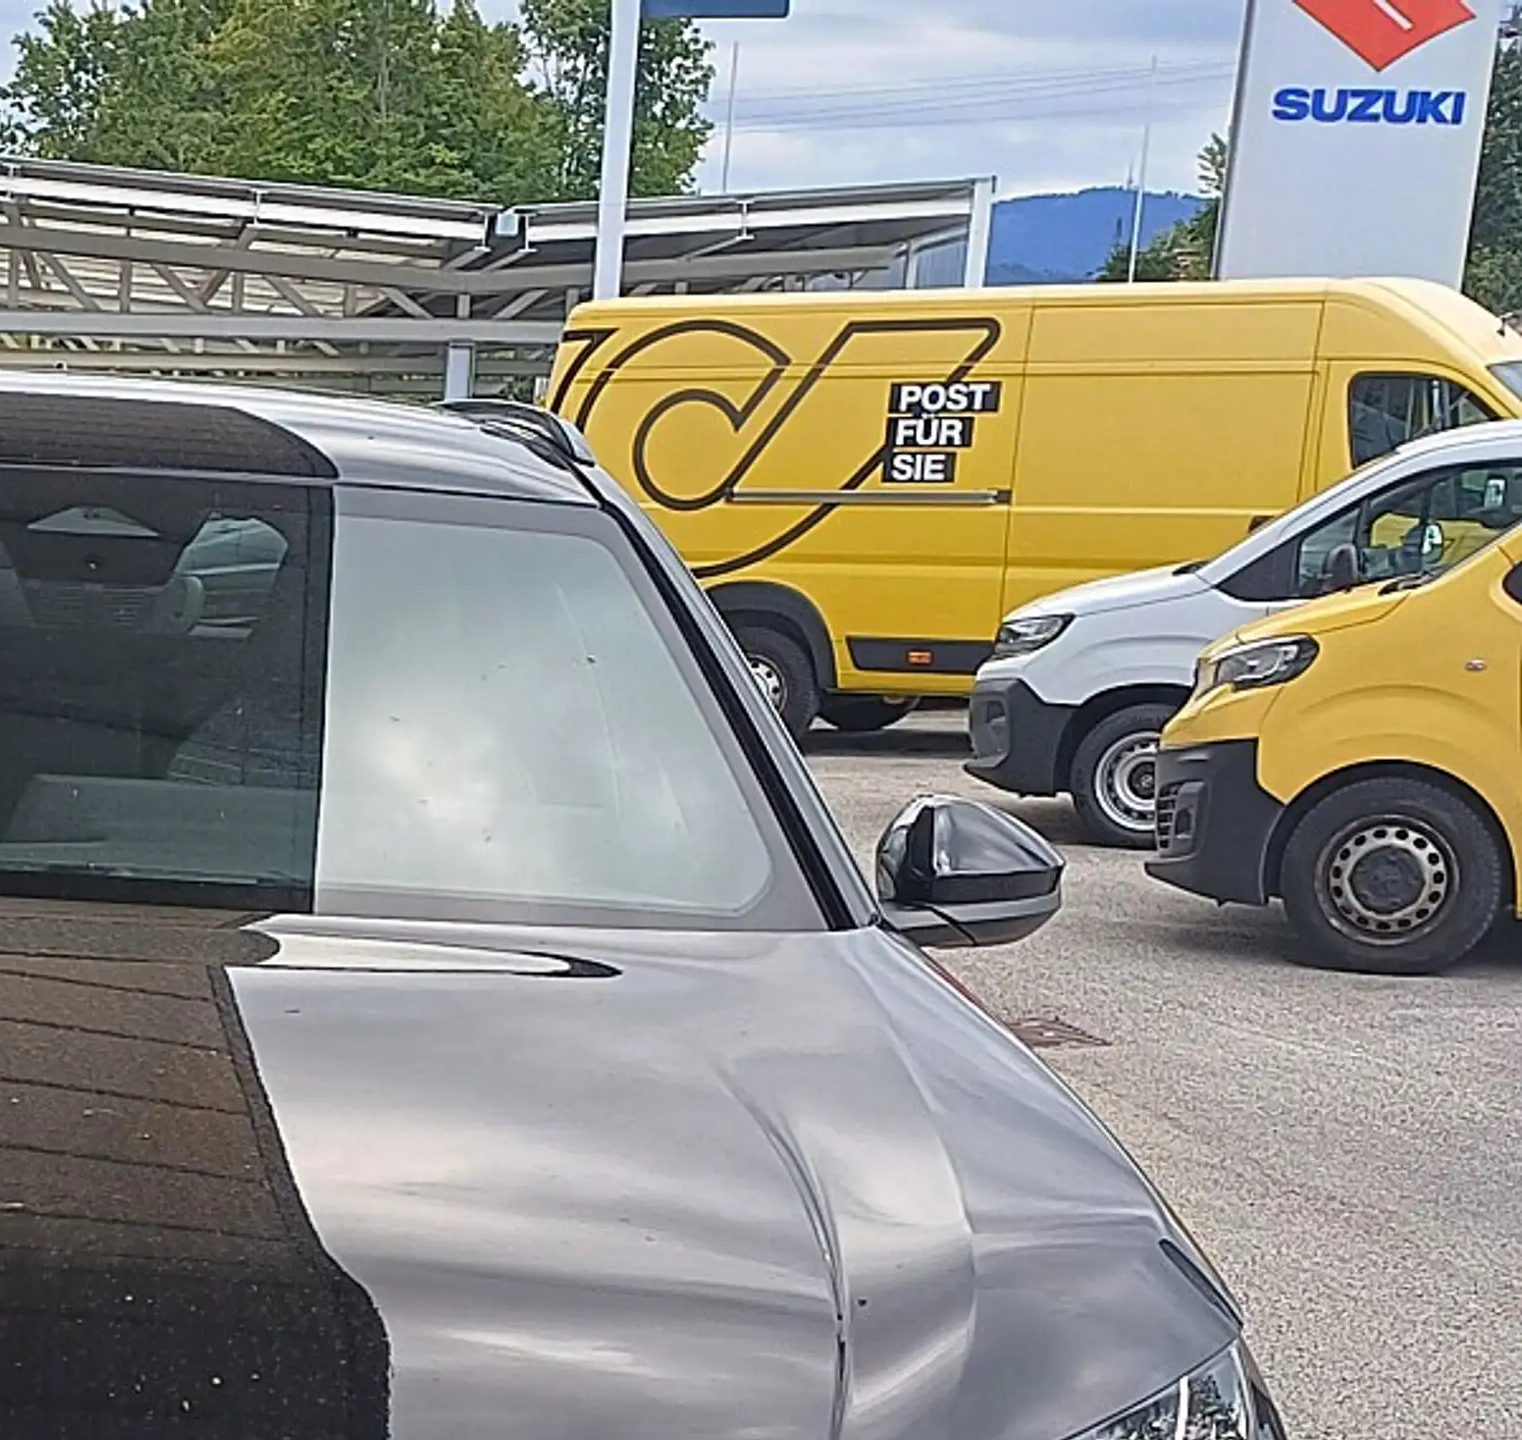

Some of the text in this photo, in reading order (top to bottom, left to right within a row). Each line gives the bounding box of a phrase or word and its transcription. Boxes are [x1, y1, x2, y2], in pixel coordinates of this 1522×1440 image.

[1272, 88, 1466, 125] SUZUKI
[899, 383, 991, 412] POST
[895, 413, 963, 445] FÜR
[891, 454, 947, 481] SIE
